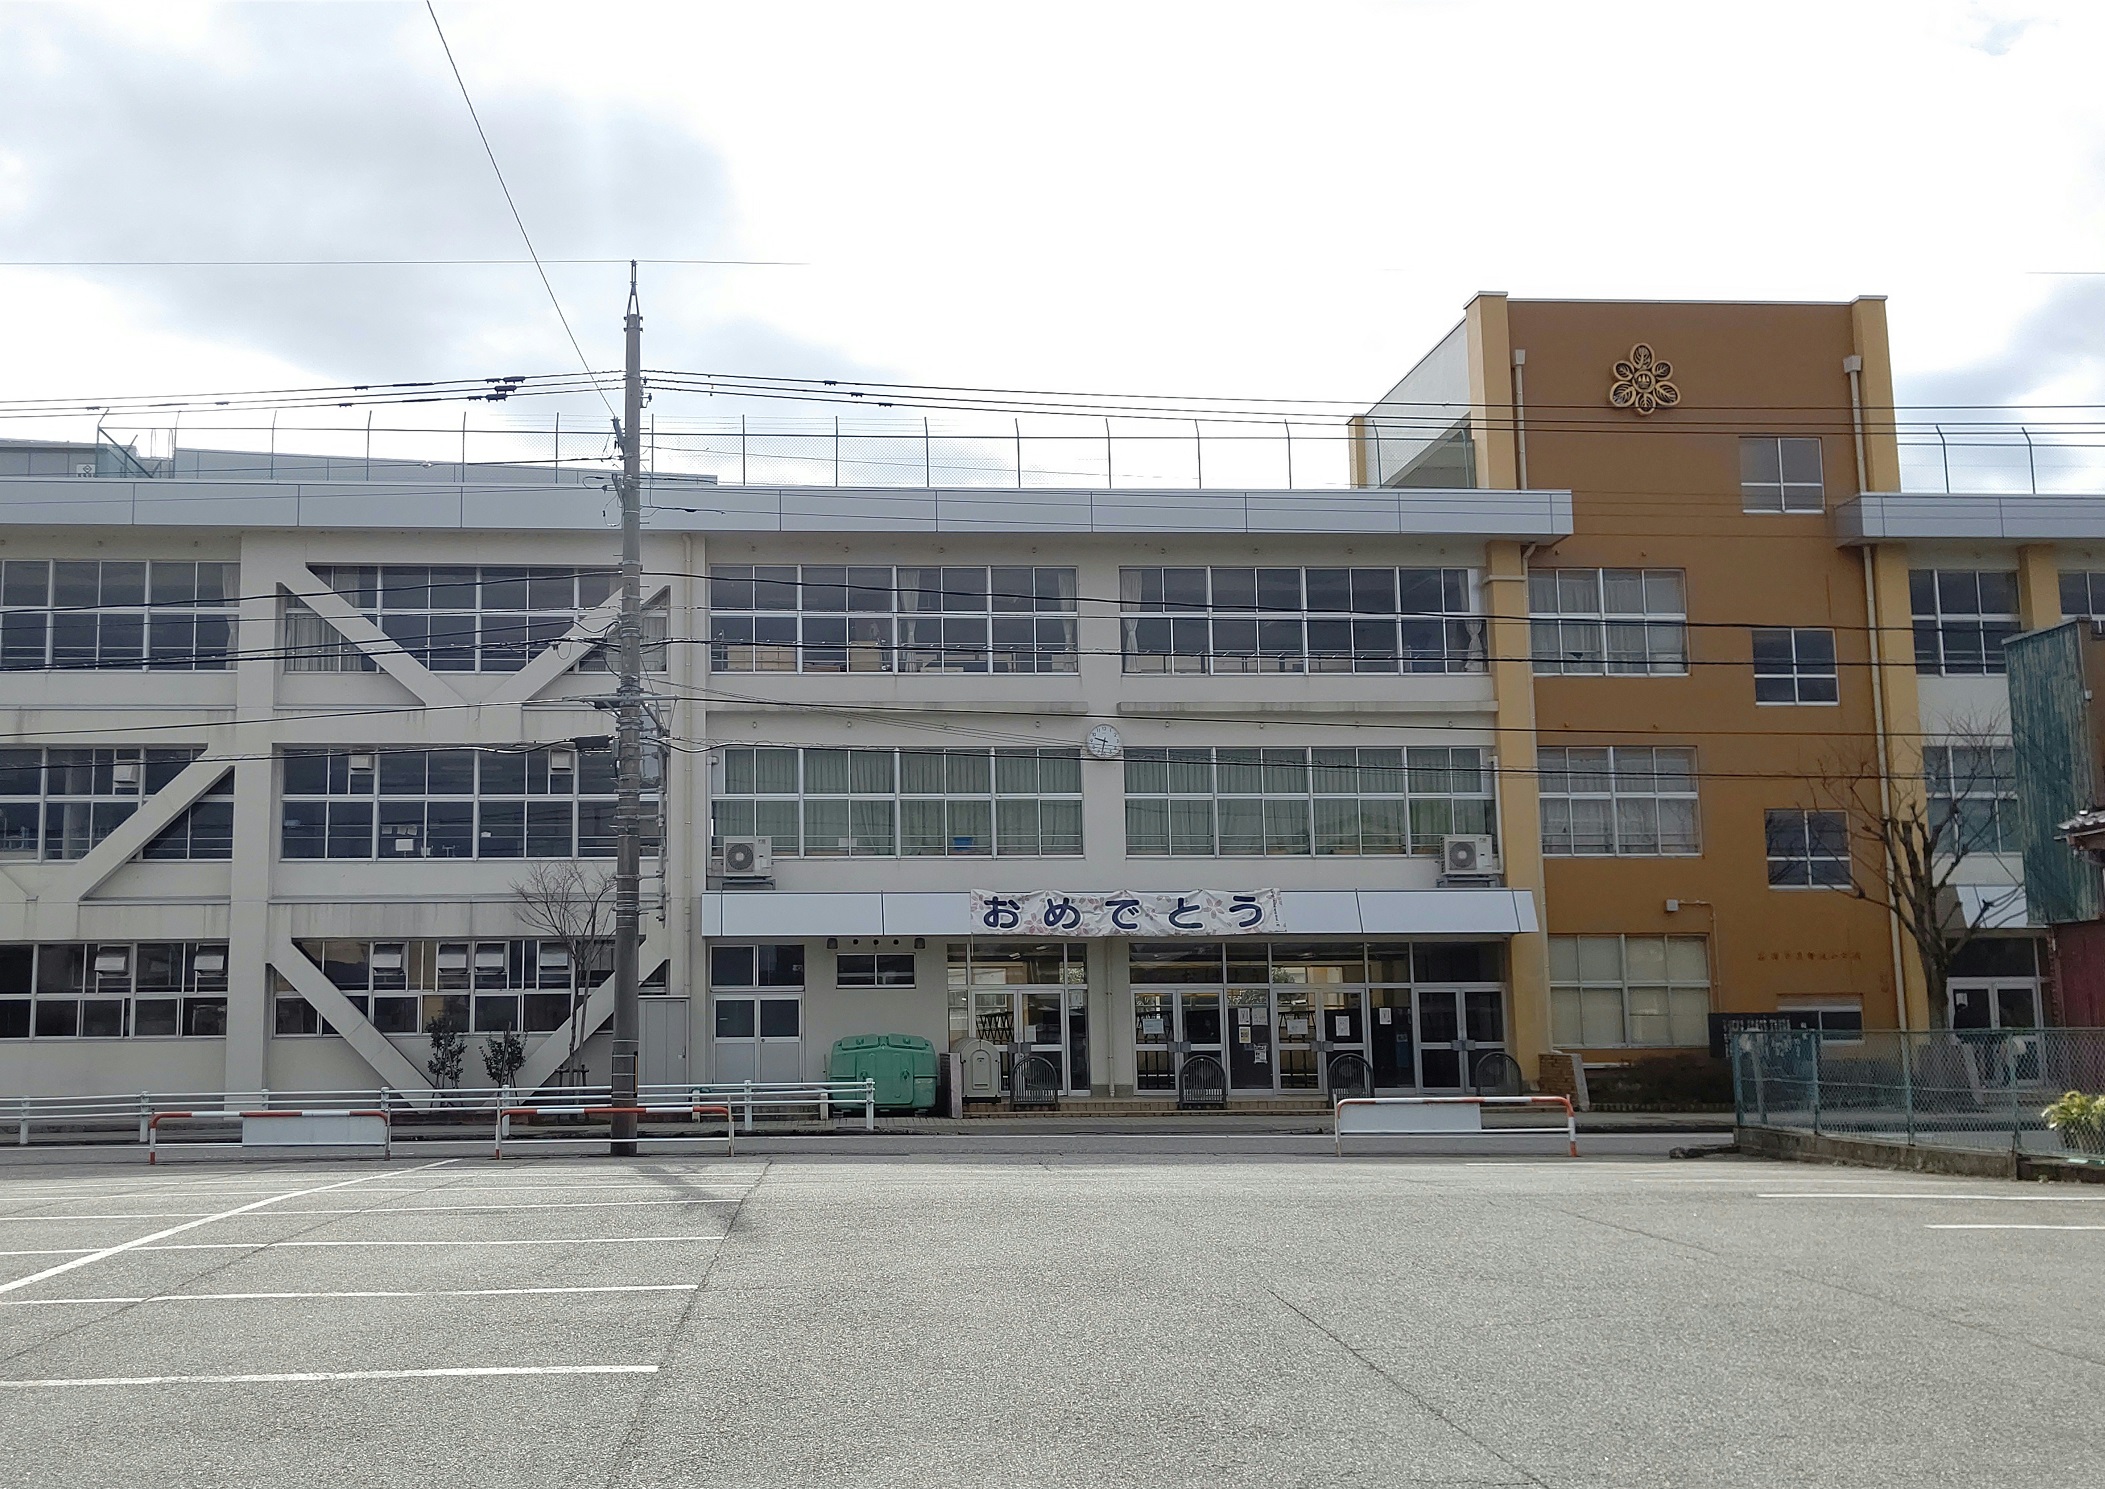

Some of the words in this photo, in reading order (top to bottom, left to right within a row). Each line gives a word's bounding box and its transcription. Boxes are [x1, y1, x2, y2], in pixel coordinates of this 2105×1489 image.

[983, 895, 1263, 930] おめでとう
